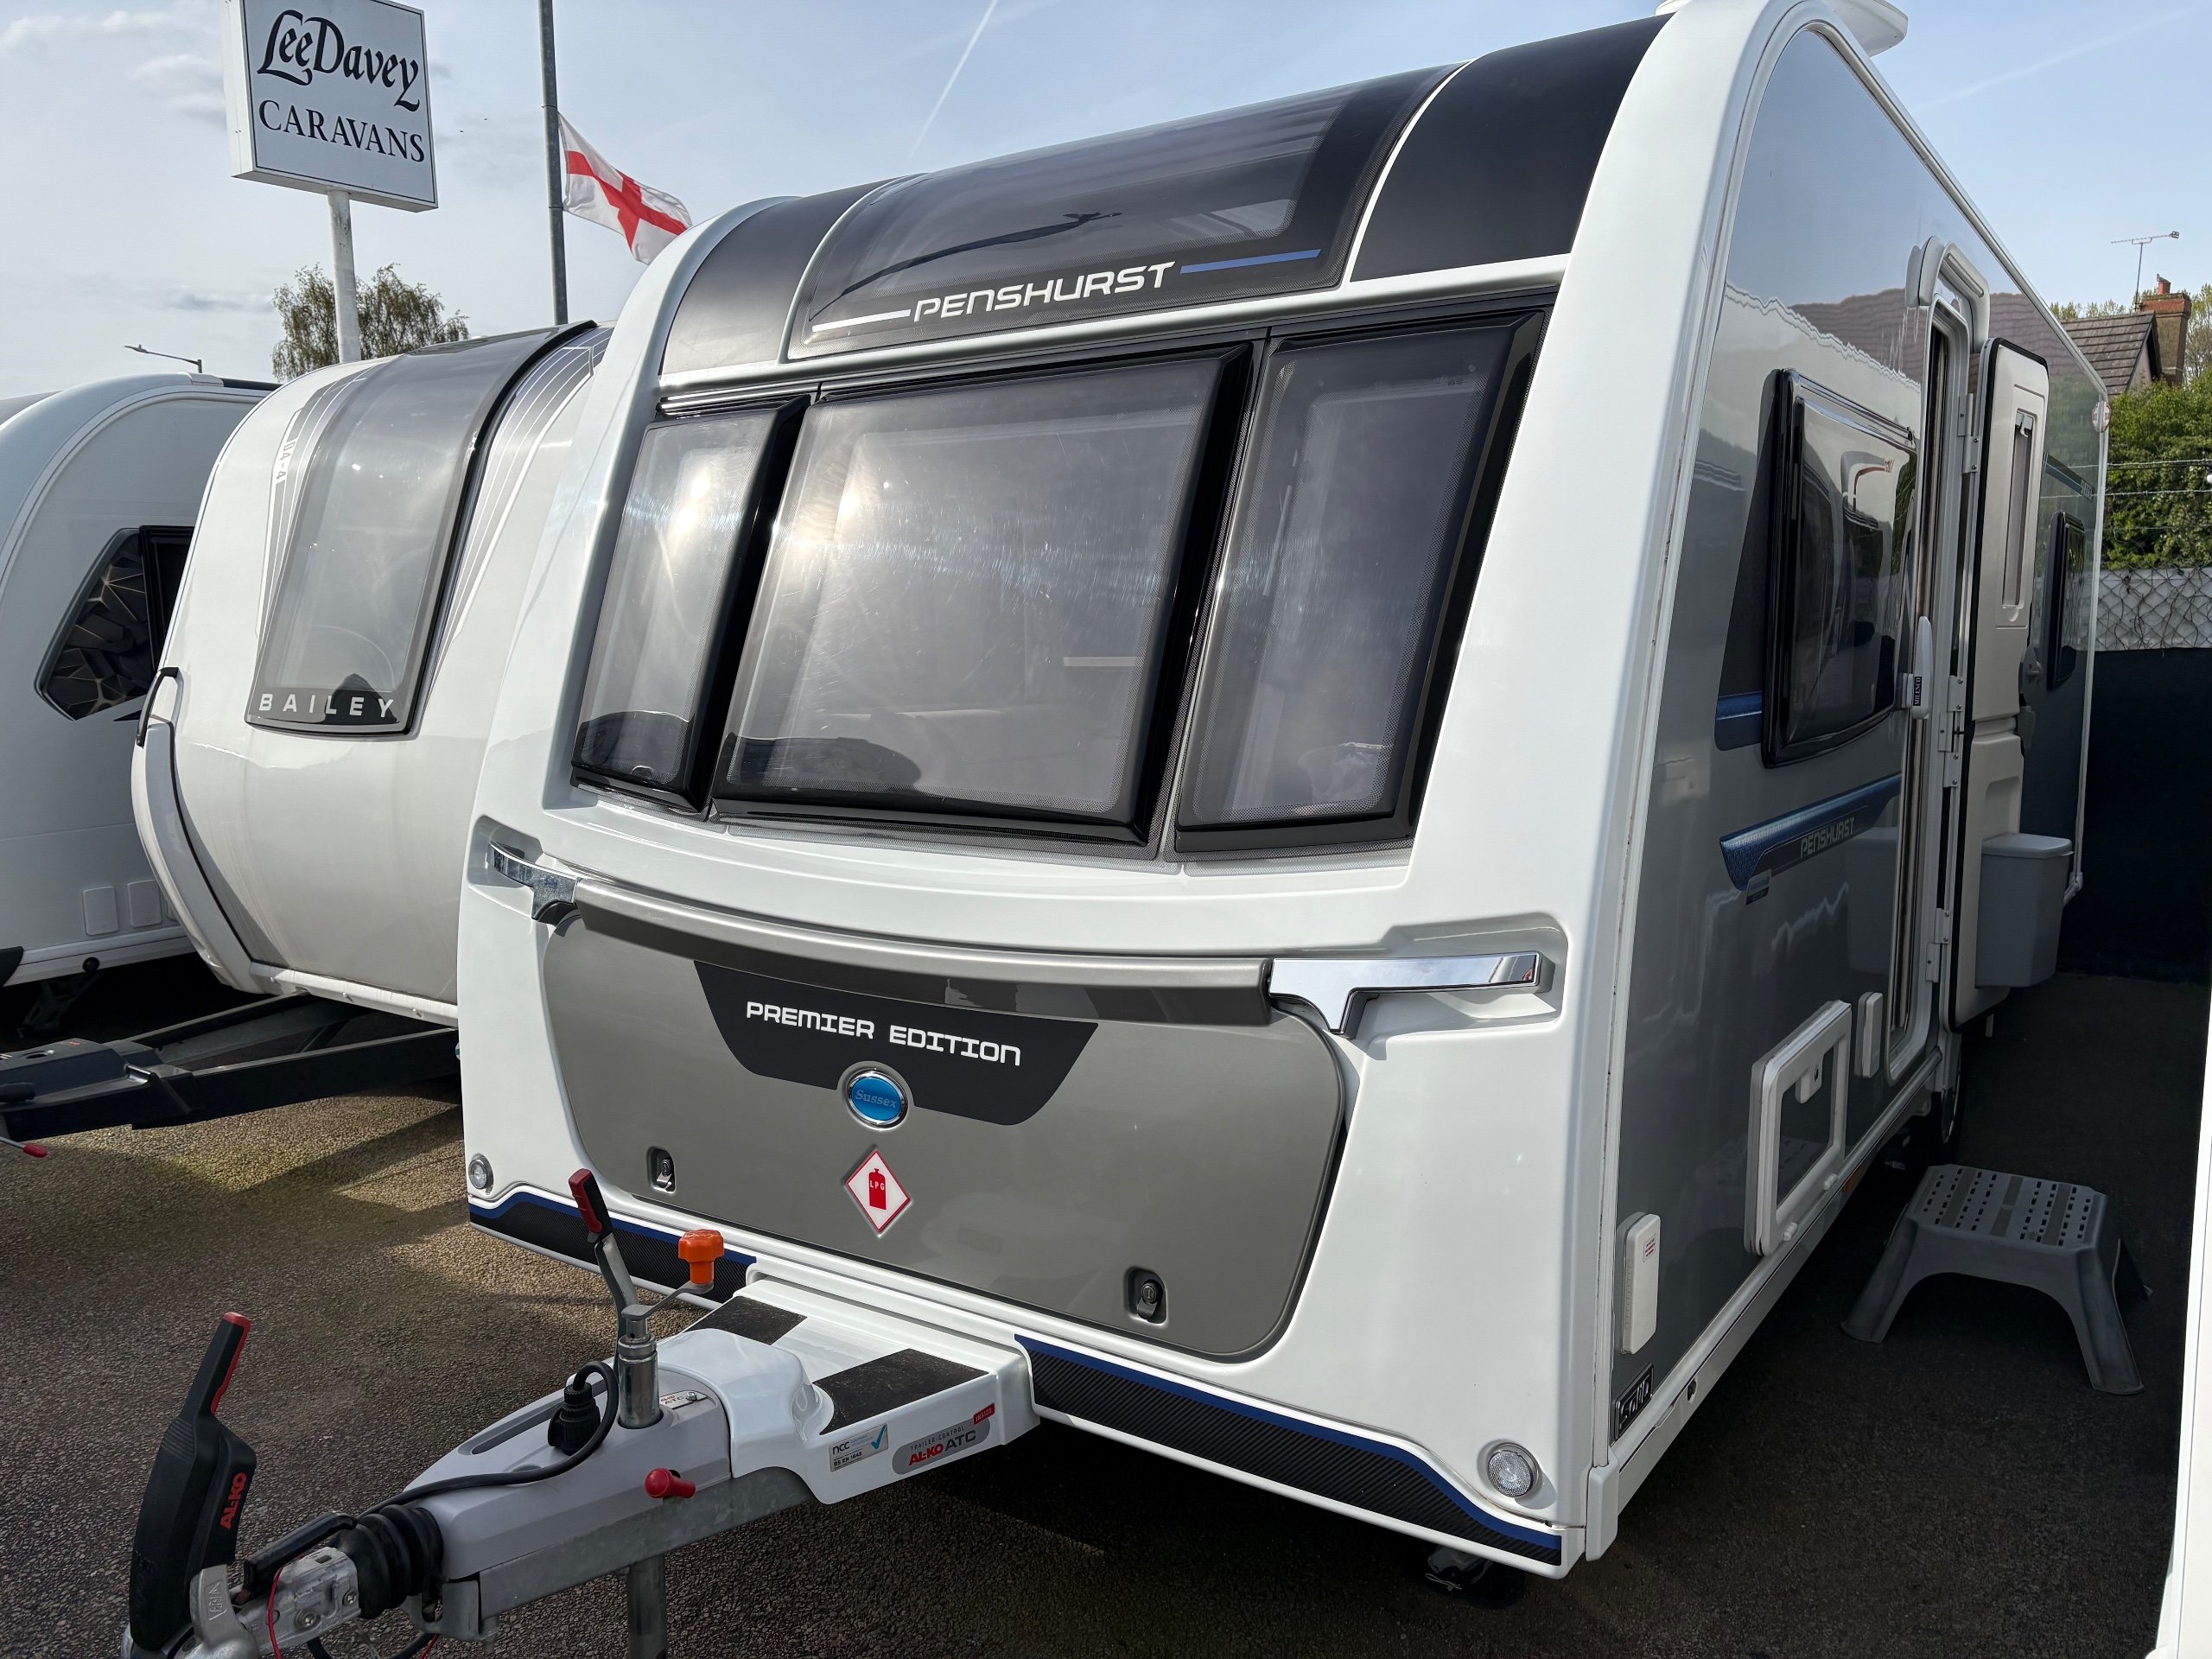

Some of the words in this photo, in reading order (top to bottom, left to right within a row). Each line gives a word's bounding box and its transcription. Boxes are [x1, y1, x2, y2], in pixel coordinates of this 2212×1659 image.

[258, 99, 425, 162] CARAVANS
[913, 261, 1176, 322] PENSHURST
[258, 693, 394, 718] BAILEY
[1800, 817, 1855, 858] PENSHURST
[747, 1001, 875, 1039] PREMIER
[889, 1025, 1021, 1066] EDITION
[855, 1090, 898, 1109] Sussex
[869, 1179, 885, 1191] LPG
[976, 1407, 992, 1422] INSIDE
[911, 1437, 936, 1451] TRAILER
[938, 1426, 965, 1440] CONTROL
[945, 1430, 976, 1452] ATC
[219, 1471, 247, 1530] AL-KO
